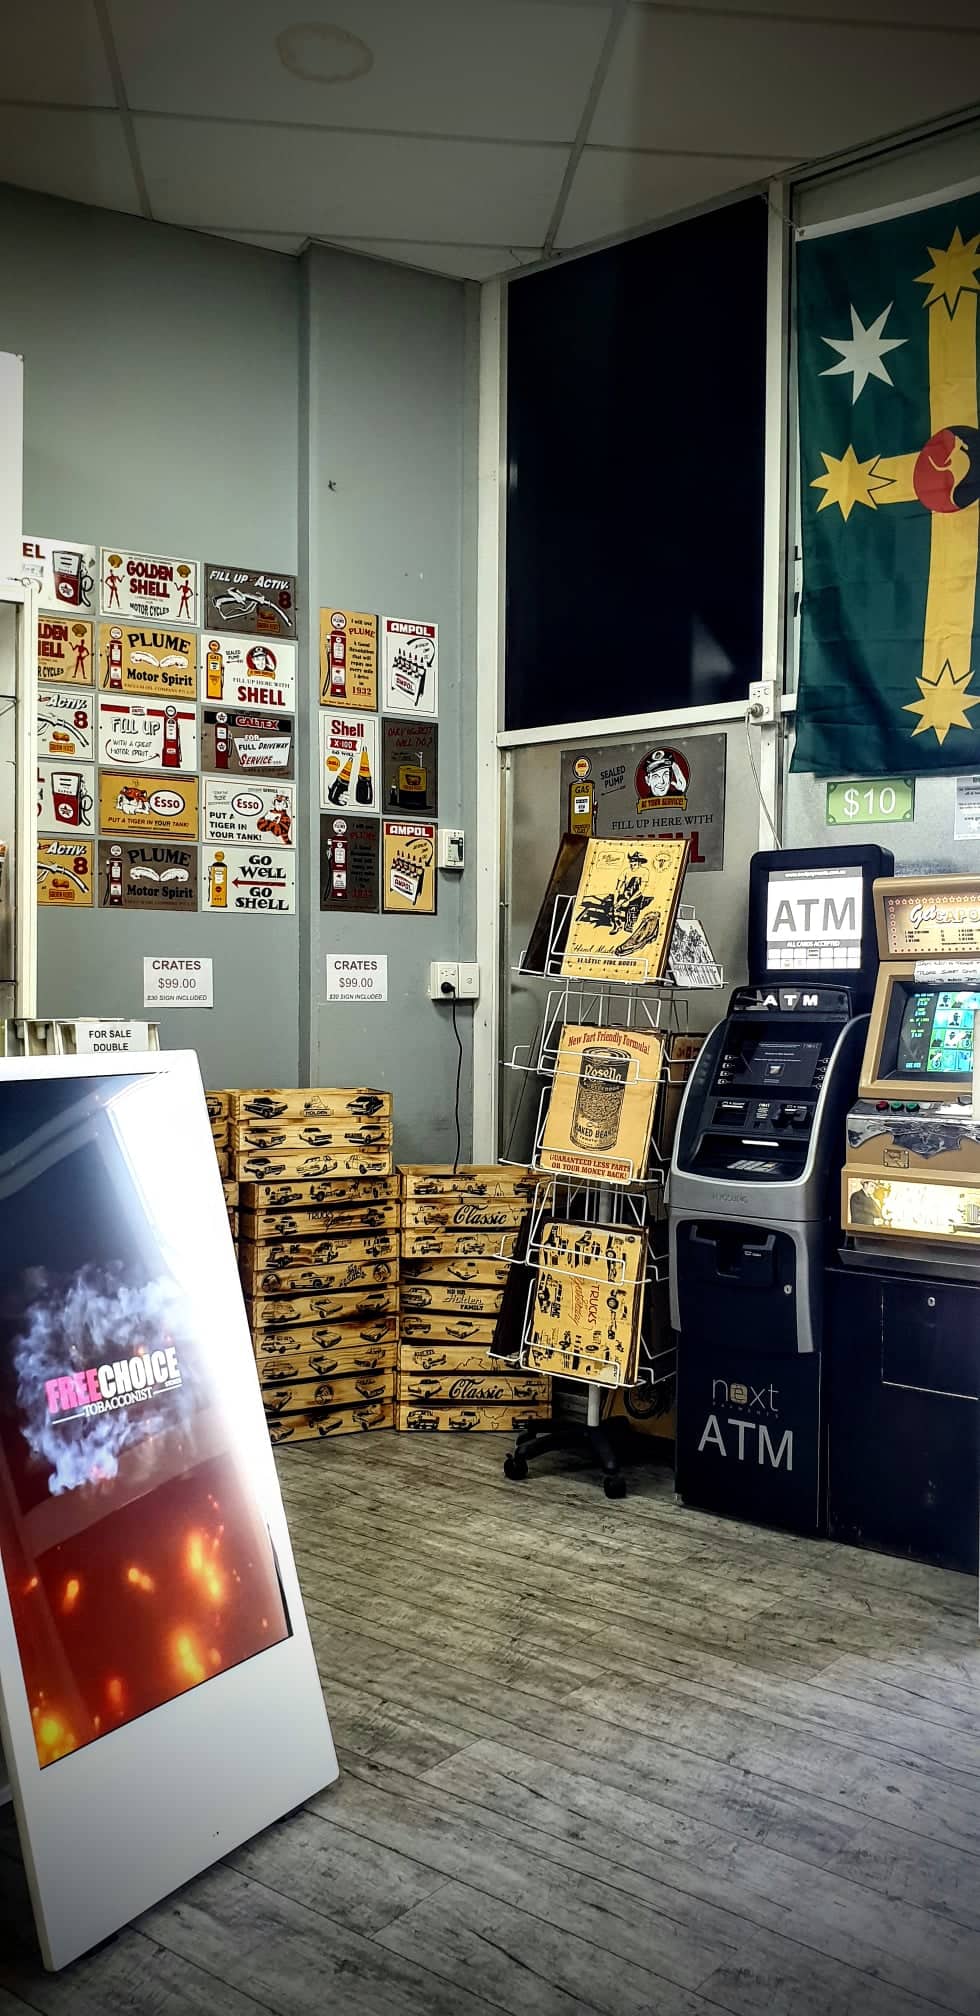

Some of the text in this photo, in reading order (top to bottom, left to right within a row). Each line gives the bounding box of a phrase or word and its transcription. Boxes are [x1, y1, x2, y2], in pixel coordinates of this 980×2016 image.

[126, 560, 174, 581] GOLDEN
[209, 570, 231, 582] FILL
[233, 574, 249, 584] UP
[129, 579, 170, 598] SHELL
[129, 602, 169, 616] MOTOR CYCLES
[348, 627, 376, 639] PLUME
[390, 622, 432, 637] AMPOL
[127, 633, 191, 655] PLUME
[42, 666, 65, 678] CYCLES
[127, 668, 159, 682] Motor
[161, 672, 193, 687] Spirit
[237, 685, 287, 707] SHELL
[351, 685, 373, 697] 1932
[73, 710, 89, 730] 8
[112, 718, 161, 736] FILL UP
[235, 715, 280, 731] CALTEX
[331, 719, 365, 738] Shell
[238, 742, 289, 751] FULL DRIVEWAY
[600, 764, 626, 780] SEALED
[574, 784, 590, 794] GAS
[604, 775, 624, 788] PUMP
[843, 786, 897, 817] $10
[209, 811, 236, 820] PUT A
[611, 814, 714, 831] FILL UP HERE WITH
[209, 821, 248, 831] TIGER IN
[389, 825, 431, 837] AMPOL
[209, 831, 263, 841] YOUR TANK!
[73, 856, 88, 875] 8
[127, 848, 191, 867] PLUME
[248, 854, 273, 866] GO
[127, 884, 193, 900] Motor Spirit
[249, 886, 273, 898] GO
[771, 896, 856, 933] ATM
[152, 960, 202, 970] CRATES
[334, 960, 378, 970] CRATES
[158, 977, 197, 989] $99.00
[338, 977, 374, 988] $99.00
[762, 993, 819, 1007] ATM
[88, 1029, 132, 1039] FOR SALE
[93, 1042, 129, 1052] DOUBLE
[567, 1031, 651, 1056] New Fart Friendly Formula!
[549, 1152, 592, 1168] GUARANTEED
[592, 1160, 610, 1169] LESS
[551, 1162, 628, 1180] OR YOUR MONEY BACK!
[453, 1204, 507, 1225] Classic
[448, 1378, 505, 1400] Classic
[711, 1378, 780, 1413] next
[697, 1413, 794, 1472] ATM
